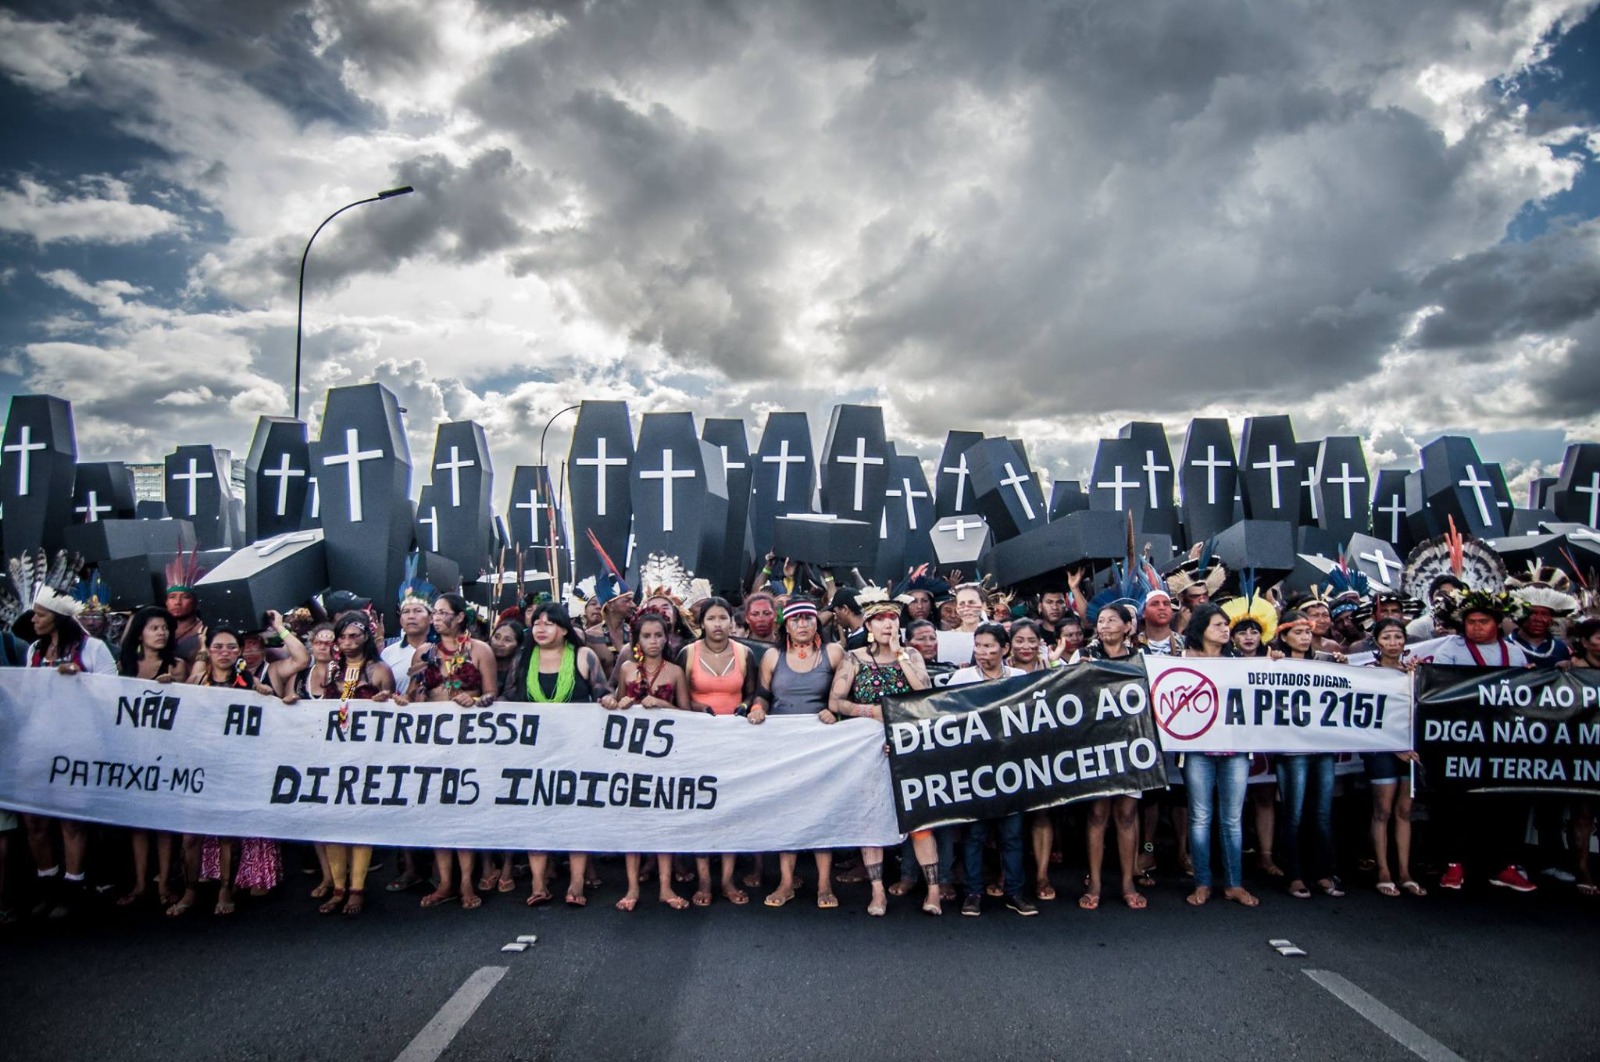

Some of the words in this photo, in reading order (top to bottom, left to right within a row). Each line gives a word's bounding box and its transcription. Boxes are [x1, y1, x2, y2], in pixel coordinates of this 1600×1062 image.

[1160, 685, 1212, 715] NÃO
[1248, 672, 1310, 687] DEPUTADOS
[1312, 674, 1352, 689] DIGAM:
[1478, 679, 1532, 706] NÃO
[1539, 685, 1574, 707] AO
[1582, 686, 1600, 708] P
[115, 690, 181, 730] NÃO
[224, 704, 263, 736] AO
[325, 710, 541, 746] RETROCESSO
[603, 714, 675, 758] DOS
[891, 711, 992, 755] DIGA
[1000, 690, 1084, 738] NÃO
[1095, 683, 1147, 721] AO
[1225, 688, 1246, 725] A
[1254, 689, 1311, 727] PEC
[1320, 690, 1388, 729] 215!
[1424, 719, 1485, 743] DIGA
[1493, 716, 1548, 744] NÃO
[1554, 723, 1572, 744] A
[50, 755, 205, 794] PATAXÓ-MG
[270, 765, 481, 806] DIREITOS
[494, 768, 718, 810] INDIGENAS
[900, 737, 1157, 811] PRECONCEITO
[1445, 756, 1481, 778] EM
[1489, 758, 1567, 781] TERRA
